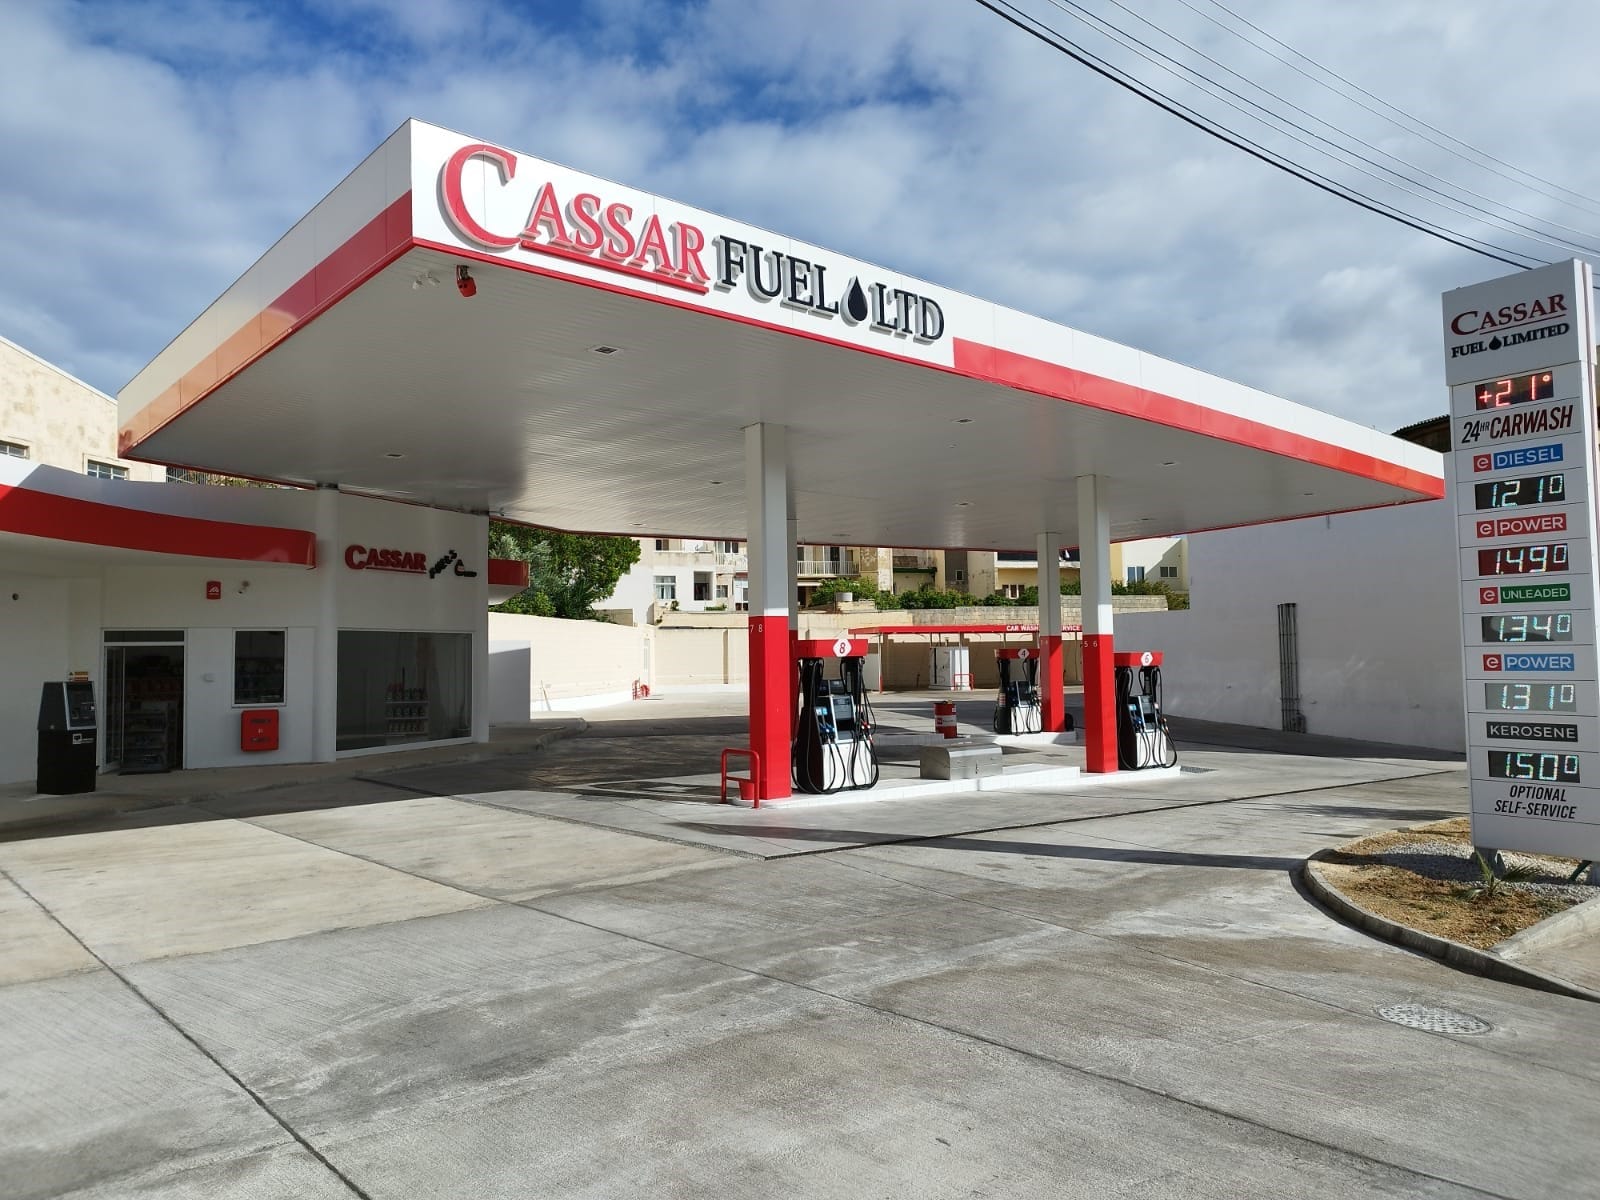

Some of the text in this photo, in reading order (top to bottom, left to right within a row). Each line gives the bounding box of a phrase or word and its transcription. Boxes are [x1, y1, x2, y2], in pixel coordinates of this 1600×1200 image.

[438, 143, 946, 344] CASSAR FUEL LTD
[1450, 293, 1568, 336] CASSAR
[1451, 322, 1571, 359] FUEL LIMITED
[1490, 404, 1574, 440] CARWASH
[1496, 447, 1561, 467] DIESEL
[1499, 516, 1564, 534] POWER
[344, 544, 427, 571] CASSAR
[1502, 587, 1569, 600] UNLEADED
[1006, 624, 1081, 632] CAR WASH RVICE
[839, 642, 846, 654] 8
[1506, 656, 1573, 669] POWER
[1490, 724, 1577, 739] KEROSENE
[1509, 784, 1568, 803] OPTIONAL
[1494, 799, 1577, 820] SELF-SERVICE
